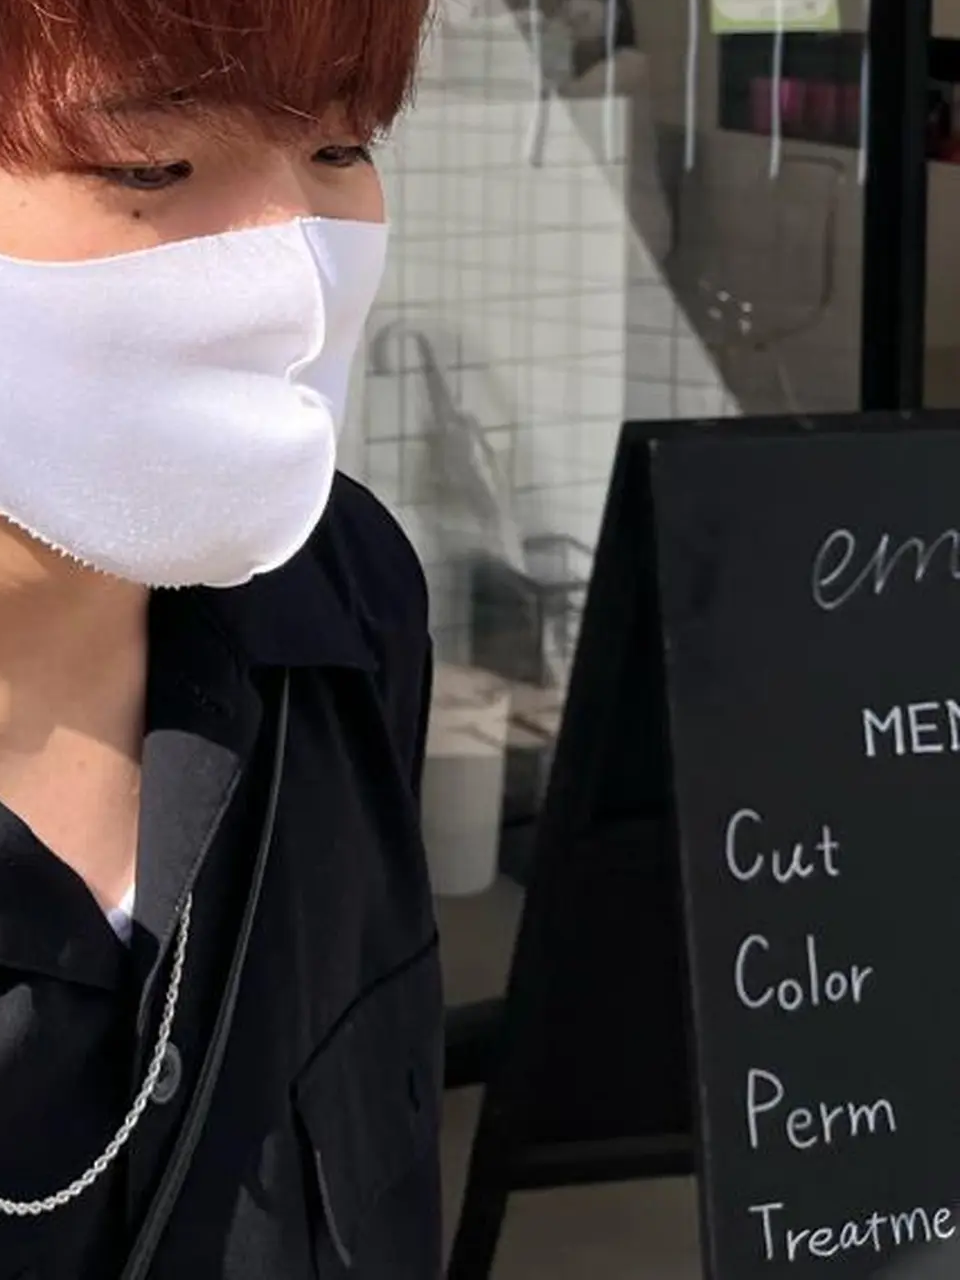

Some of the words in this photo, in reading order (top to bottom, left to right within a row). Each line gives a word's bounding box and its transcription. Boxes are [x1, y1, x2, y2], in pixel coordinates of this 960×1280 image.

[725, 808, 839, 883] Cut
[734, 933, 873, 1011] Color
[746, 1067, 897, 1149] Perm
[748, 1202, 957, 1262] Treatme
